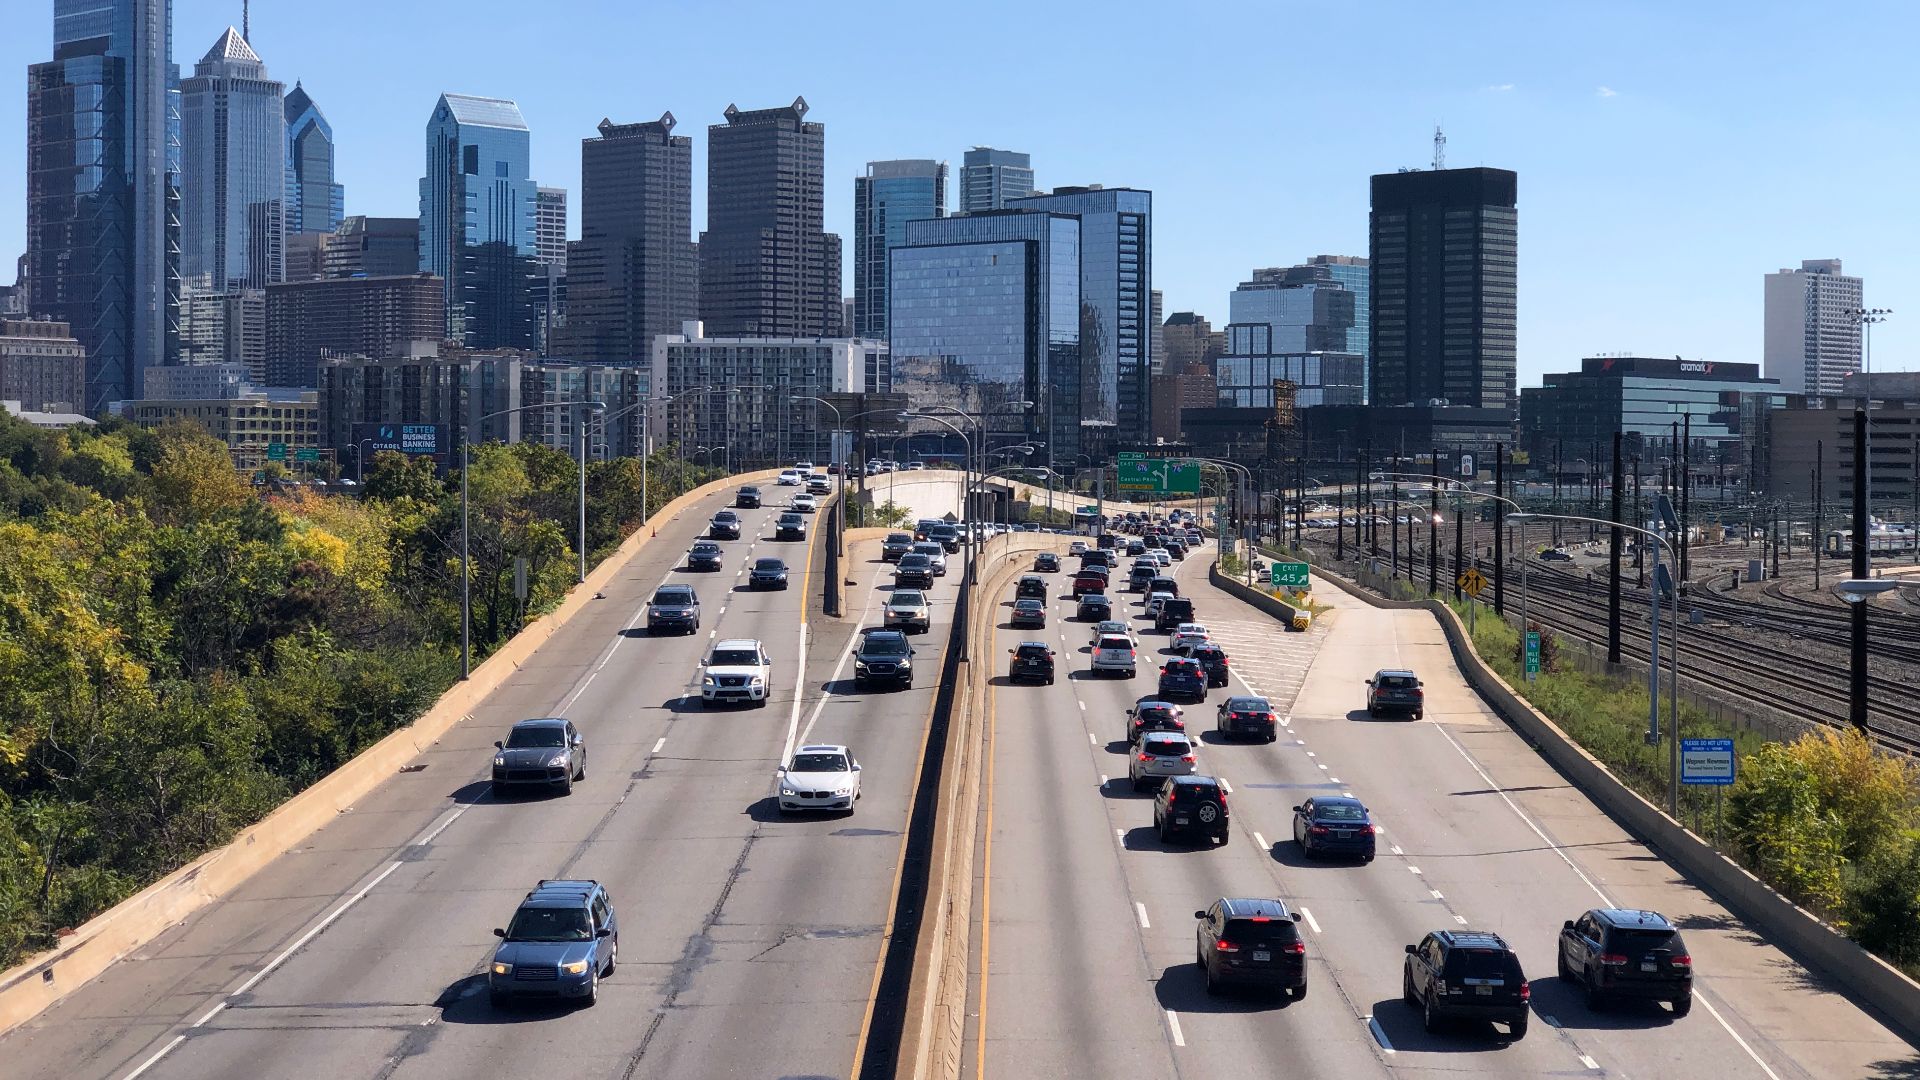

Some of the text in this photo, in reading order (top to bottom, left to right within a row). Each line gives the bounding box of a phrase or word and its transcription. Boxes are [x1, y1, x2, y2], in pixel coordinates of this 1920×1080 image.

[1680, 362, 1705, 372] aramark
[402, 425, 436, 434] BETTER
[402, 440, 436, 448] BANKING
[1137, 464, 1148, 472] 676
[1273, 573, 1296, 582] 345
